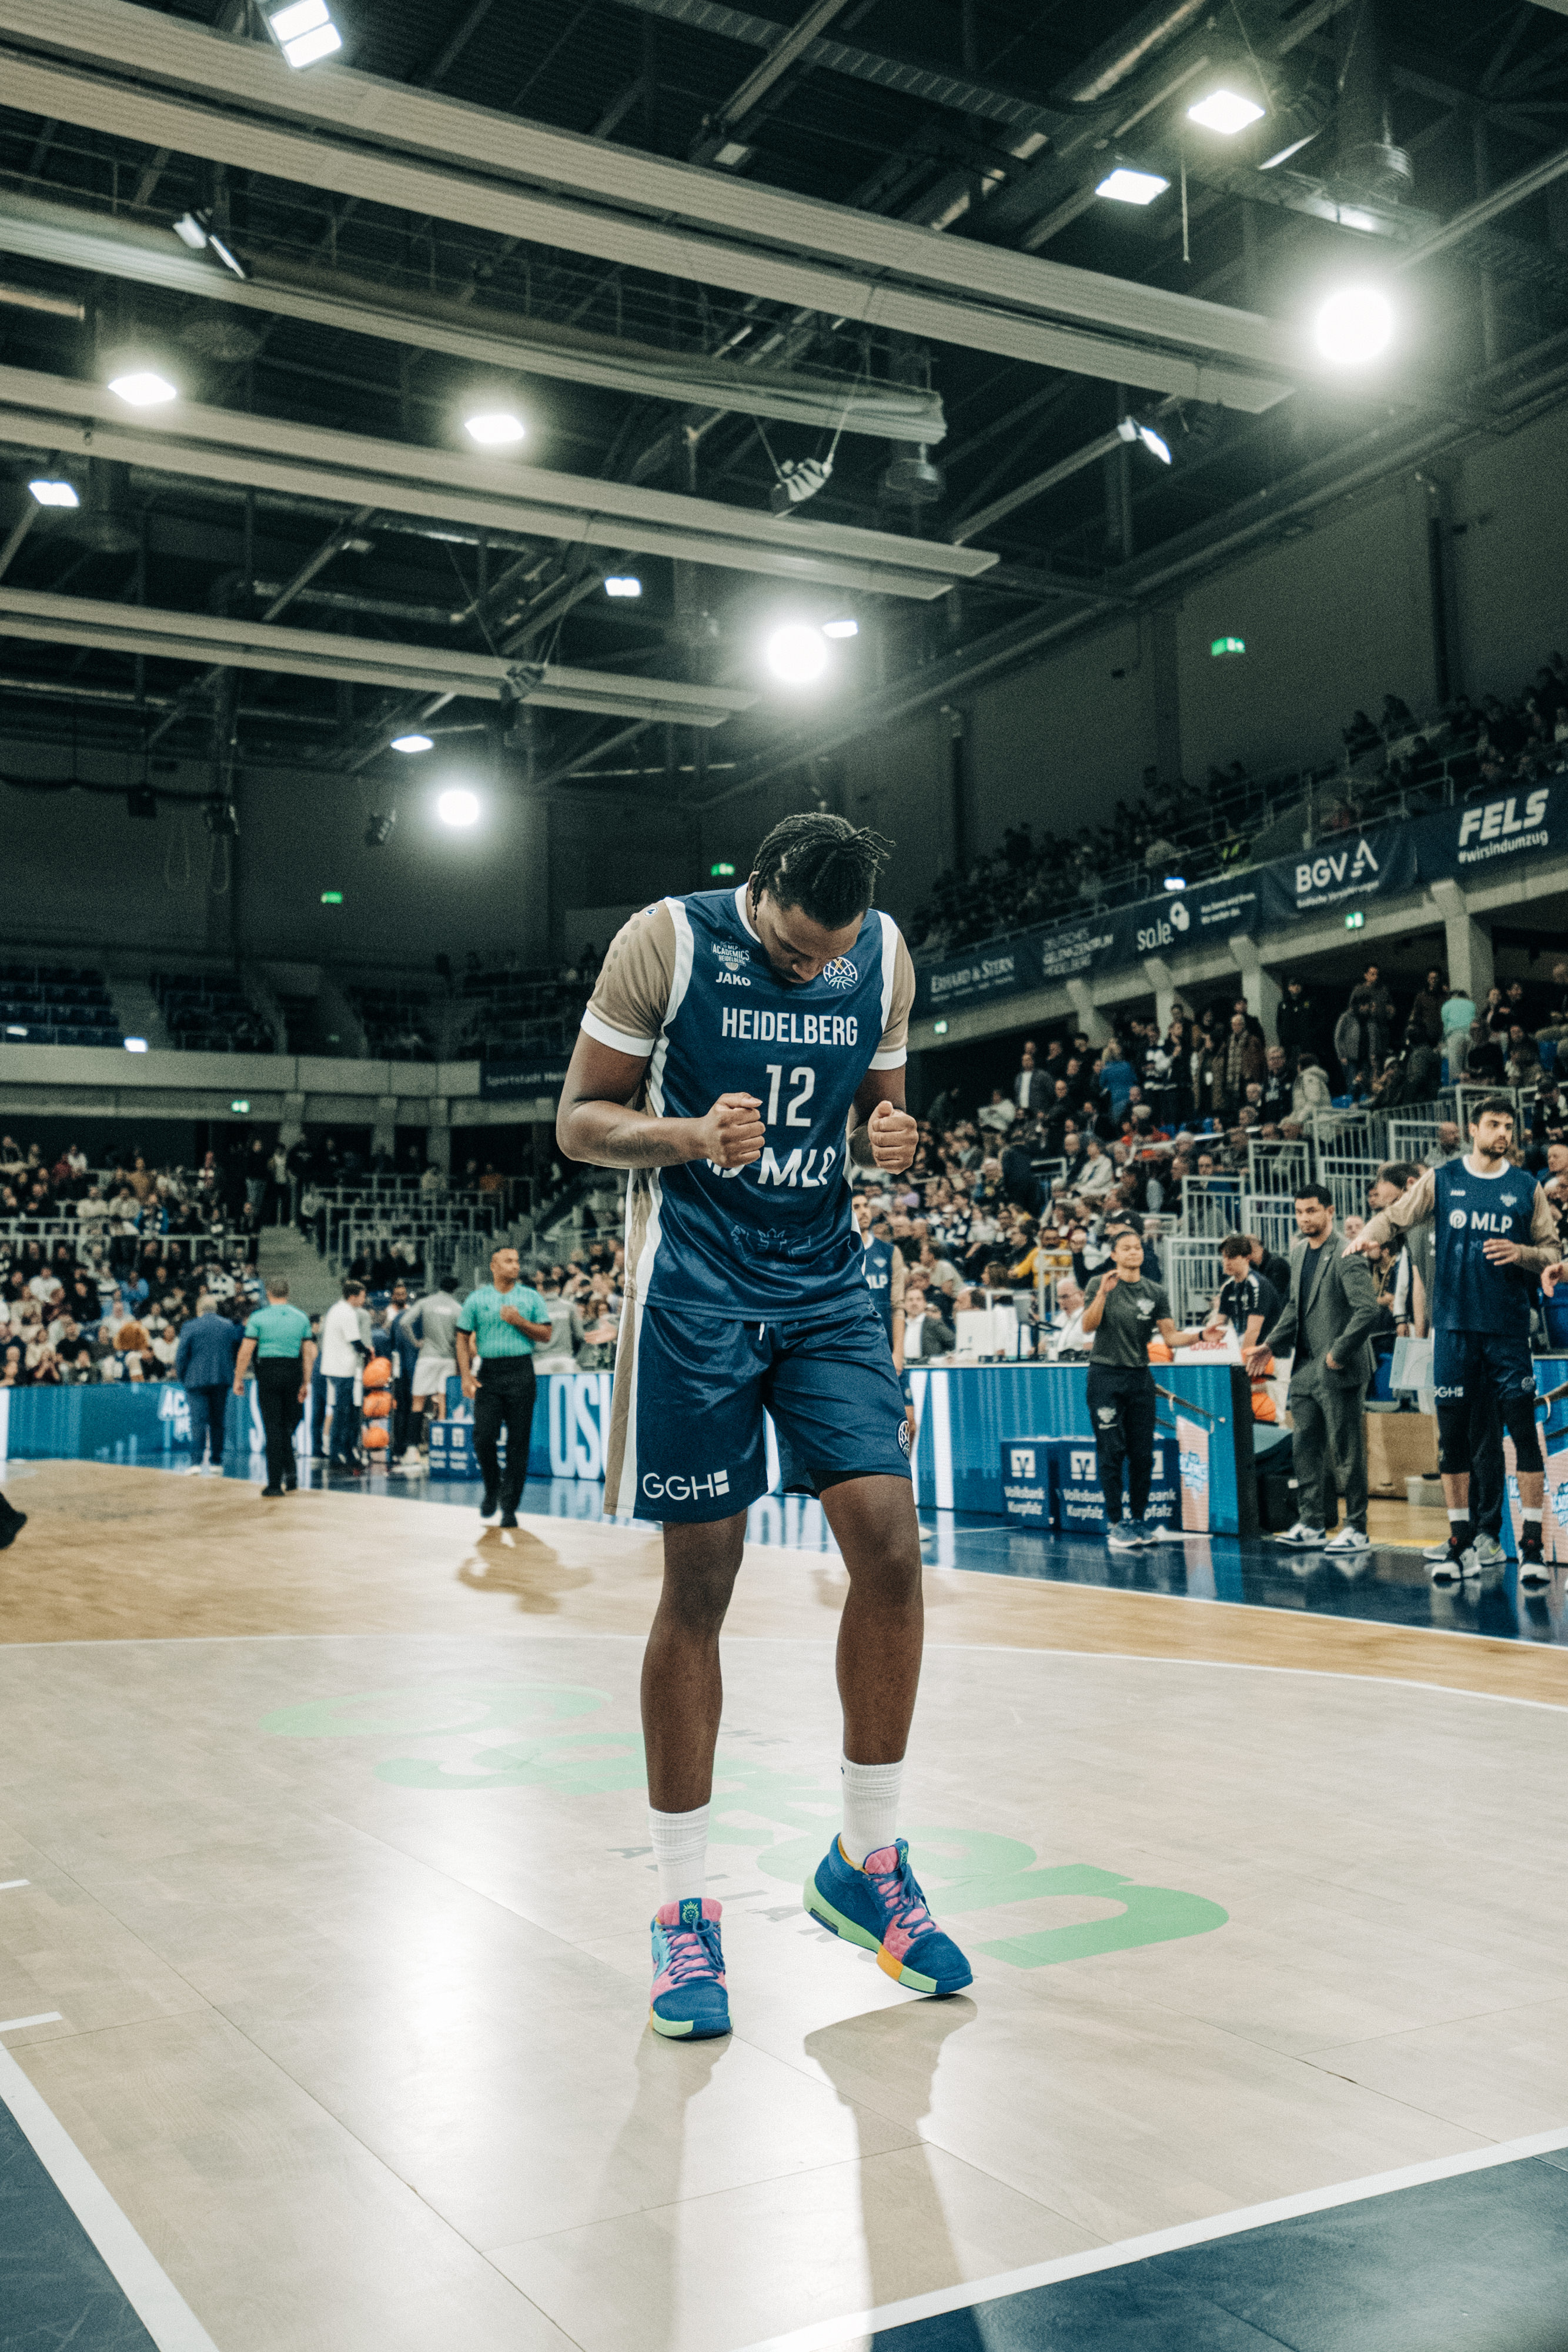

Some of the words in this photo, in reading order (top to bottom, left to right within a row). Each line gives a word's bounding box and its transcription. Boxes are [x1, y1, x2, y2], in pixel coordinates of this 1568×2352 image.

[1458, 789, 1549, 847] FELS
[1458, 830, 1549, 864] #wirsindumzug
[1295, 852, 1348, 893] BGV
[712, 943, 750, 961] ACADEMICS
[716, 971, 751, 987] JAKO
[722, 1007, 858, 1047] HEIDELBERG
[765, 1064, 815, 1128] 12
[757, 1146, 836, 1188] MLP
[1471, 1211, 1513, 1234] MLP
[643, 1472, 715, 1501] GGH
[1004, 1485, 1045, 1500] Volksbank
[1062, 1488, 1105, 1504] Volksbank
[1007, 1501, 1042, 1517] Kurpfalz
[1066, 1504, 1104, 1521] Kurpfalz
[1122, 1504, 1173, 1522] Kpfalz
